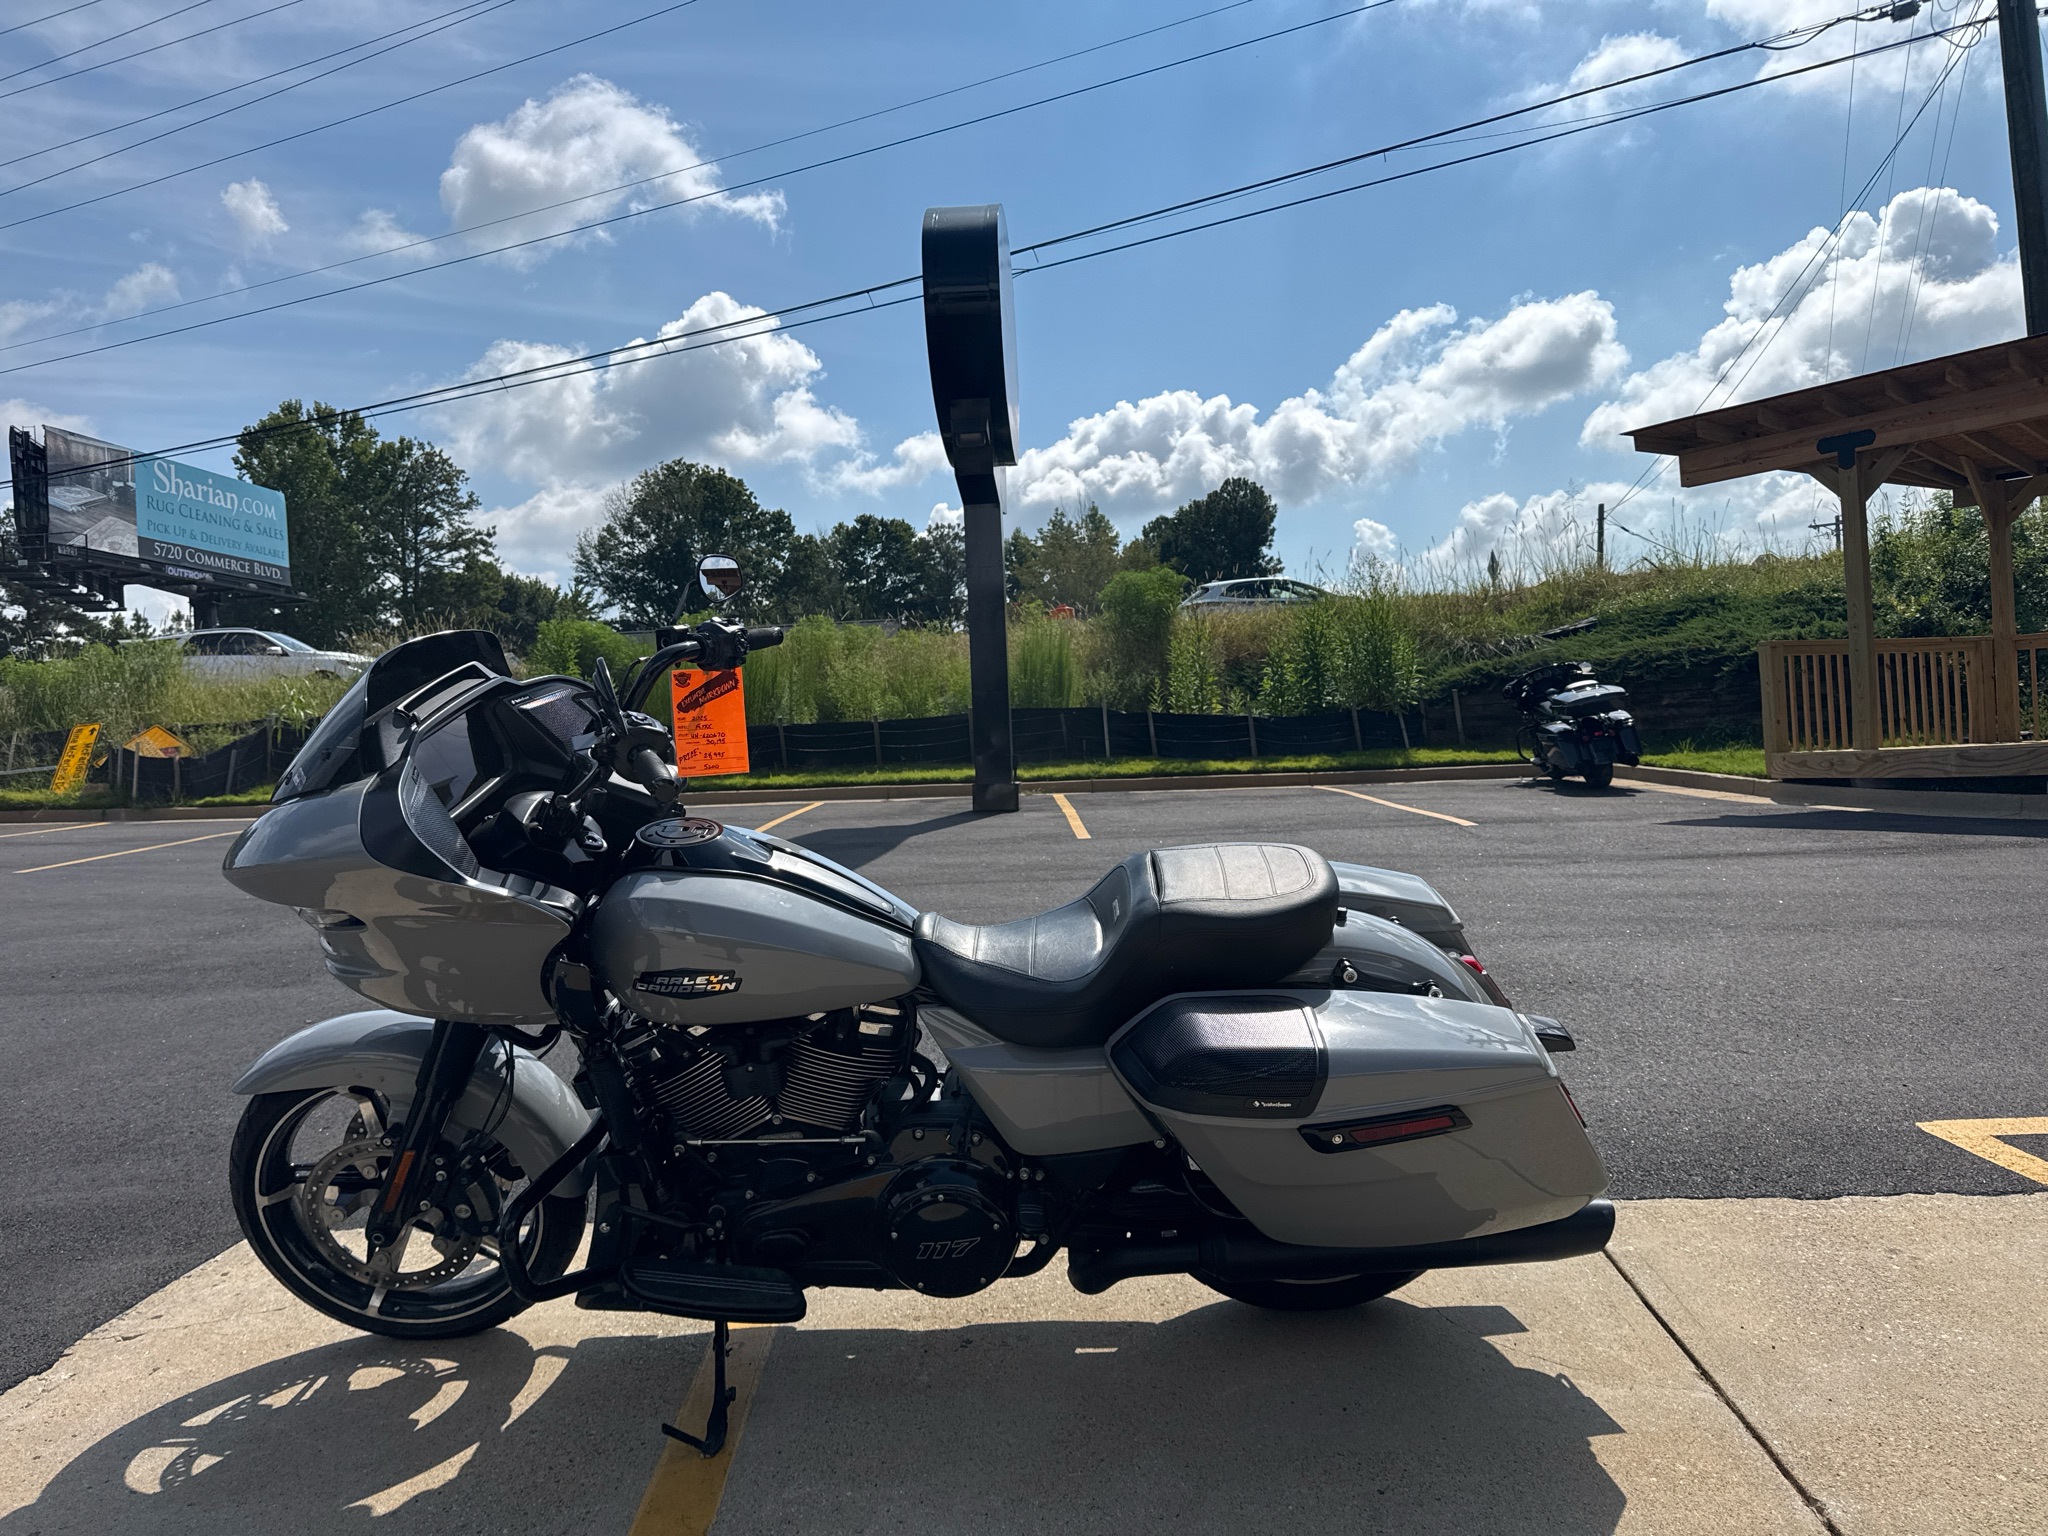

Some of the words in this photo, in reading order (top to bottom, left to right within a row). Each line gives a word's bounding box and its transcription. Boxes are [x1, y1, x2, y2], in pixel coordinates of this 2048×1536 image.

[243, 520, 253, 533] &
[189, 529, 198, 540] &
[153, 542, 182, 560] 5720
[651, 974, 729, 985] ARLEY-
[635, 982, 737, 993] DAVIDSON
[916, 1237, 981, 1259] 117
